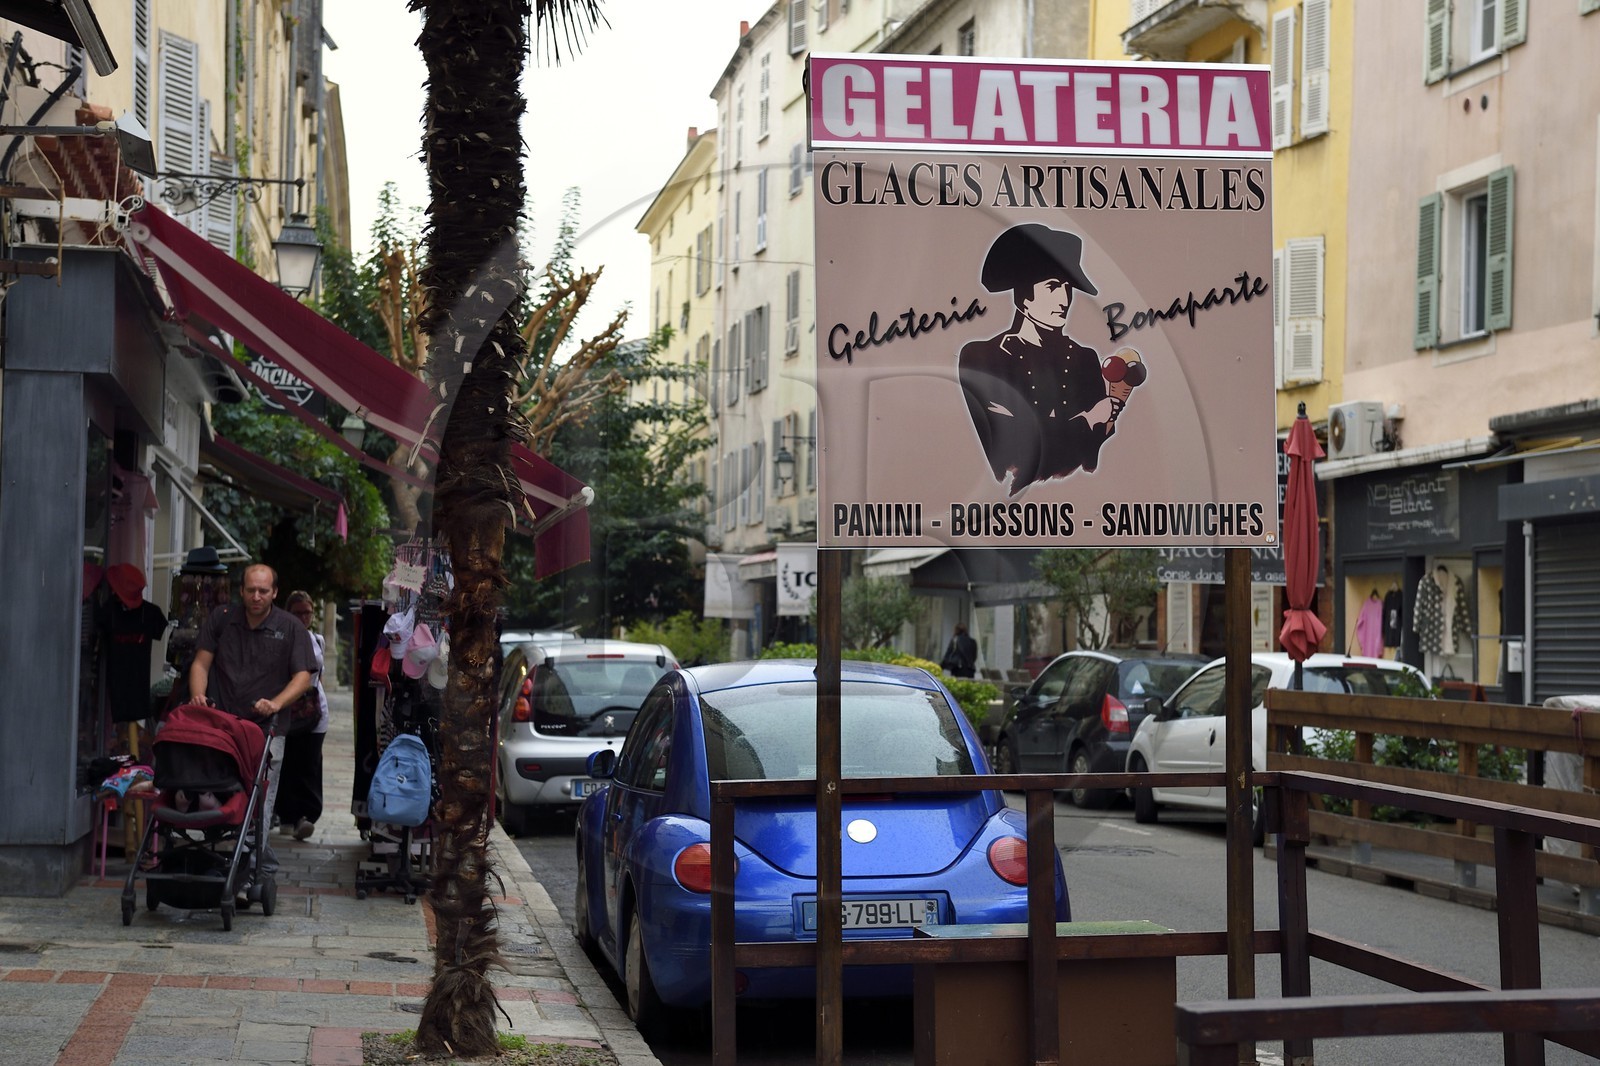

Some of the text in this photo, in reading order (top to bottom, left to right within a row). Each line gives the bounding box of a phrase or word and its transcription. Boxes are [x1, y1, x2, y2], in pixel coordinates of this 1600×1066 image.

[821, 63, 1262, 148] GELATERIA
[820, 160, 1266, 213] GLACES ARTISANALES
[827, 270, 1269, 365] Gelateria Bonaparte
[833, 502, 922, 539] PANINI
[950, 502, 1075, 539] BOISSONS
[1101, 502, 1265, 540] SANDWICHES
[1157, 566, 1190, 580] Corse
[1196, 568, 1223, 581] dans
